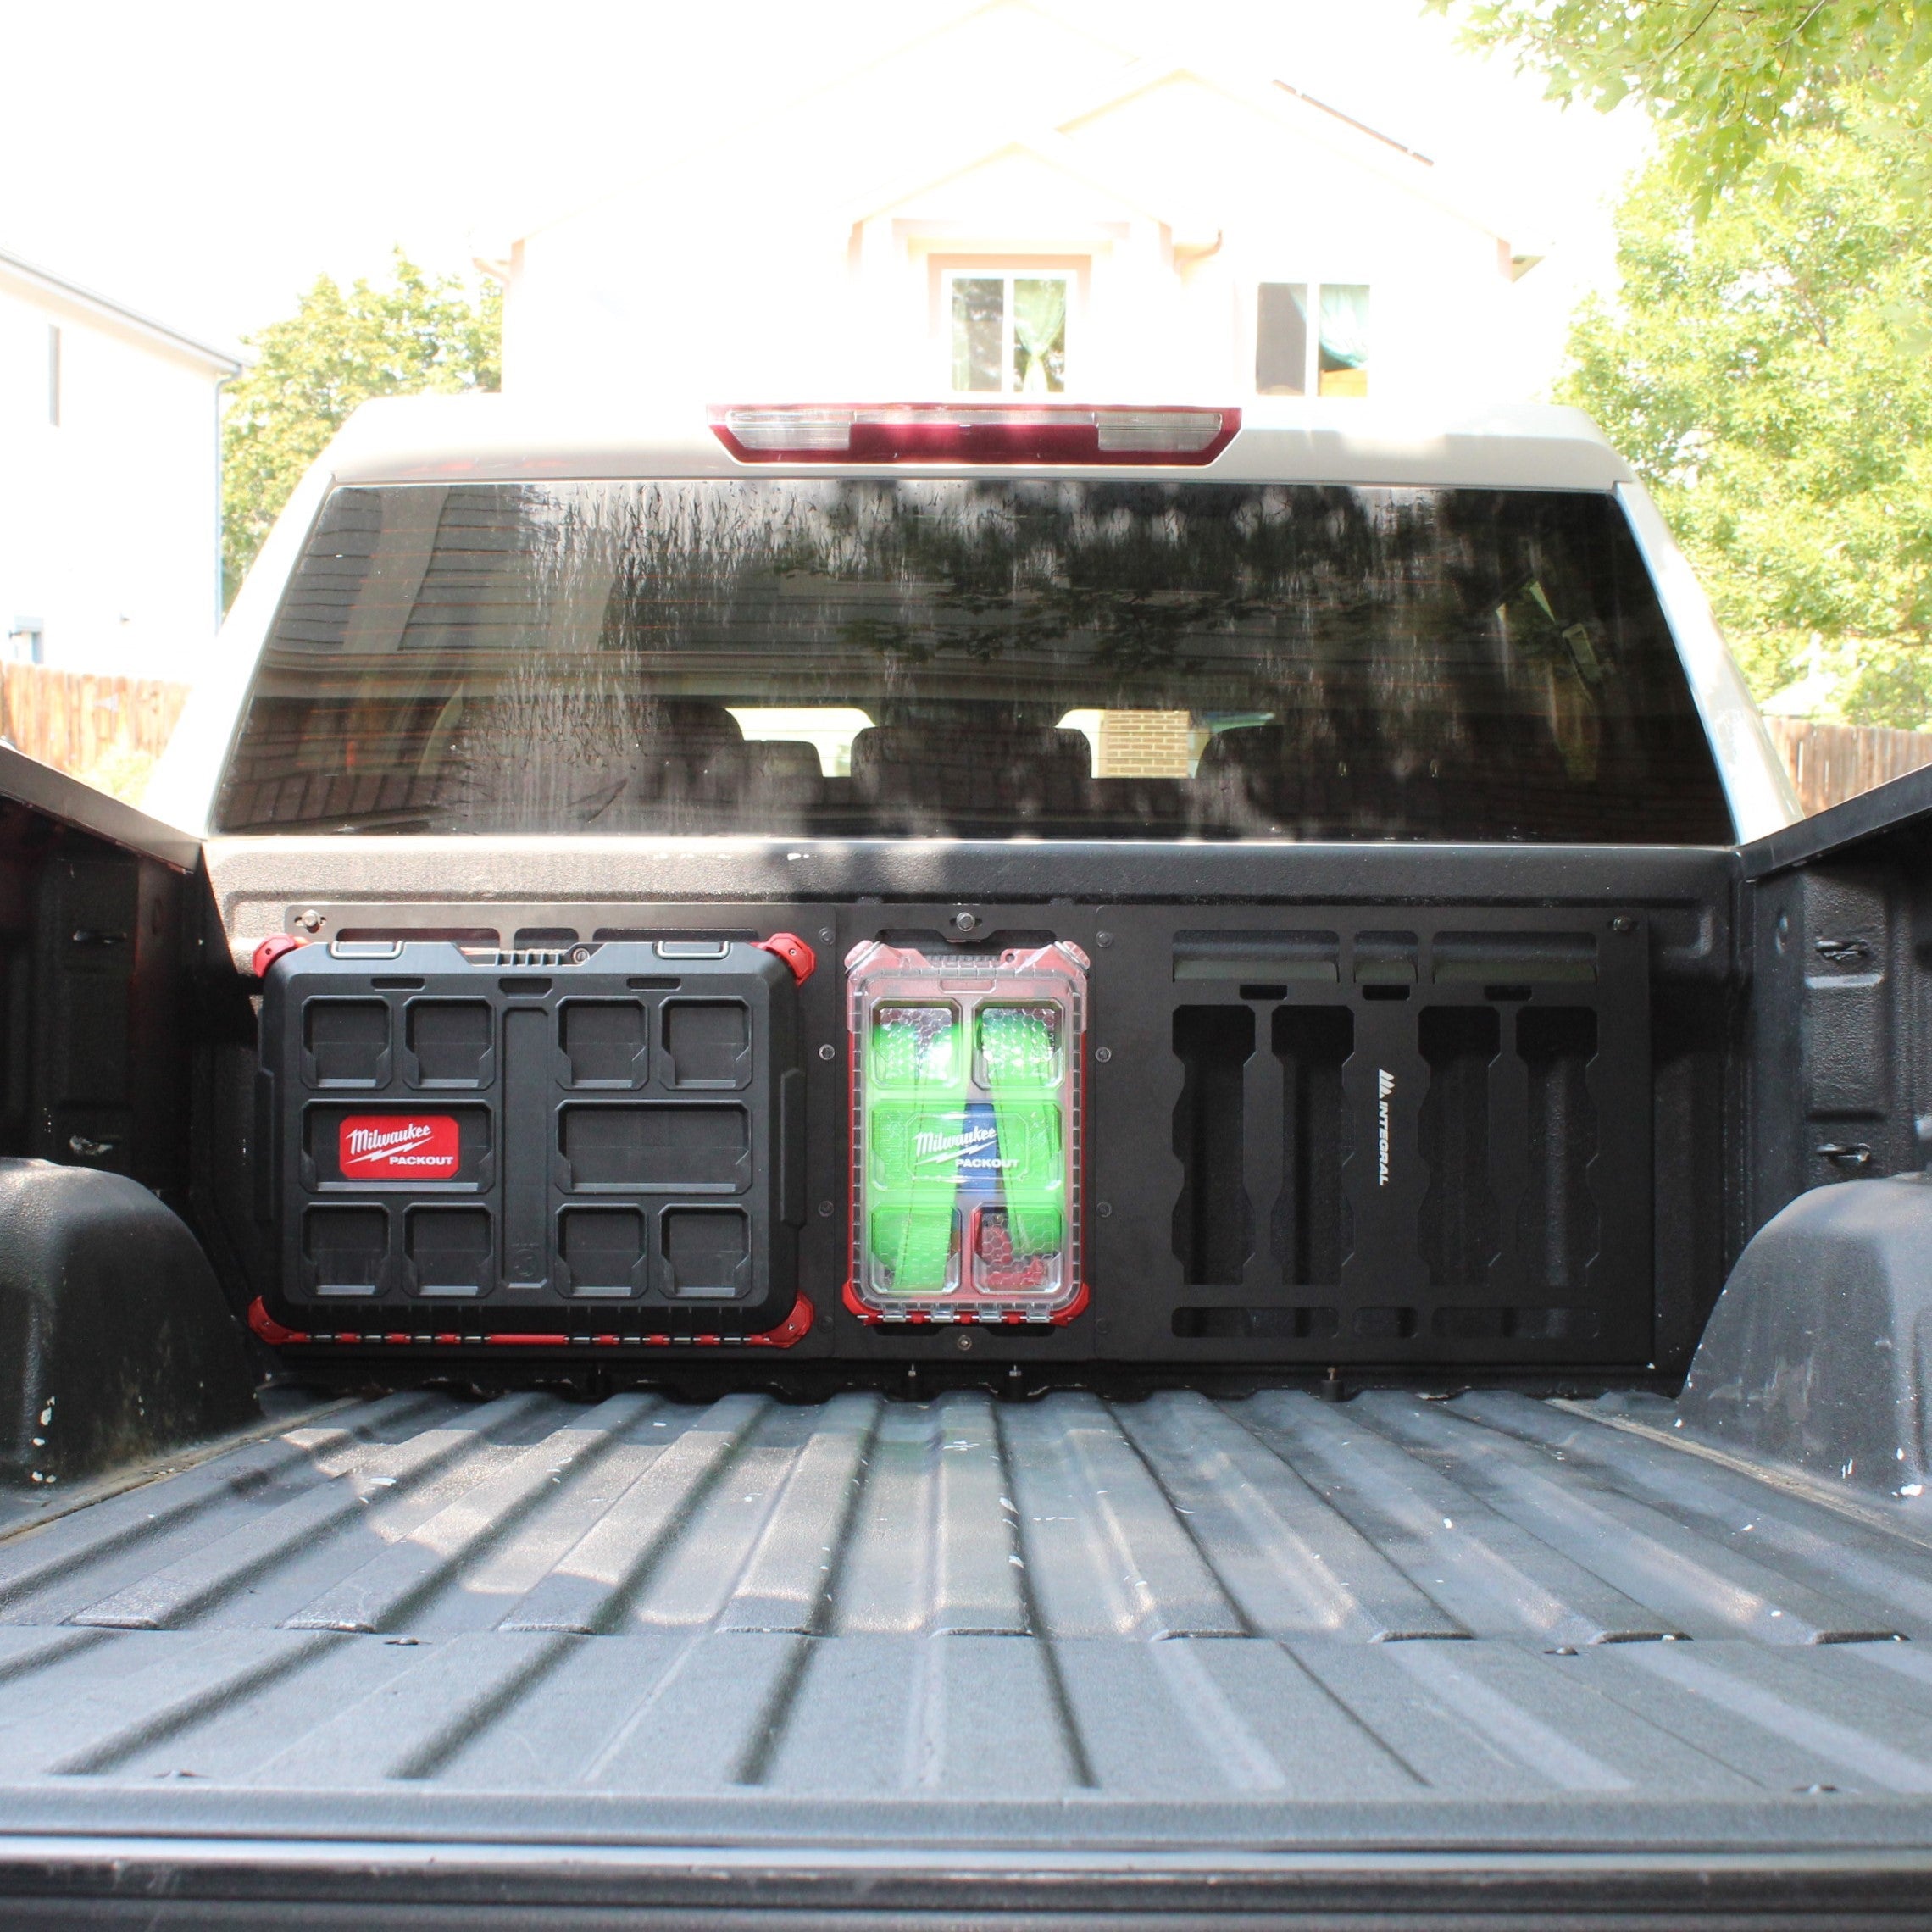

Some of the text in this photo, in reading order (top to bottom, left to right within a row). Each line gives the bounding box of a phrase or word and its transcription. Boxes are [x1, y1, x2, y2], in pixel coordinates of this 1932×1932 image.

[345, 1123, 432, 1156] Milwaukee
[912, 1125, 998, 1158] Milwaukee
[1379, 1100, 1390, 1186] INTEGRAL
[389, 1156, 454, 1166] PACKOUT
[954, 1158, 1020, 1169] PACKOUT
